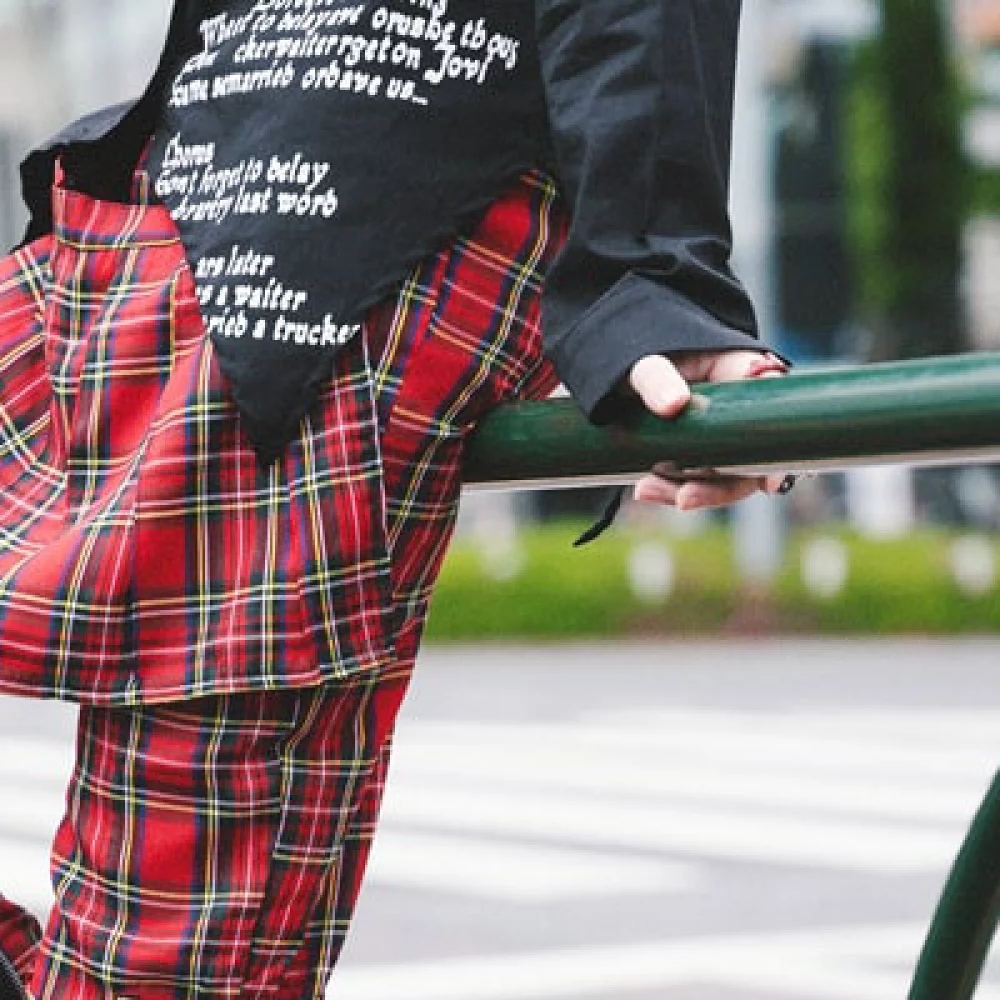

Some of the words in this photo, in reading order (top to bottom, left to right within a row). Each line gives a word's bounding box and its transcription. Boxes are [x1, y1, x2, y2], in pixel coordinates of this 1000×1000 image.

[225, 245, 275, 277] later
[234, 277, 309, 311] waiter
[252, 319, 266, 339] a
[273, 312, 361, 346] trucker
